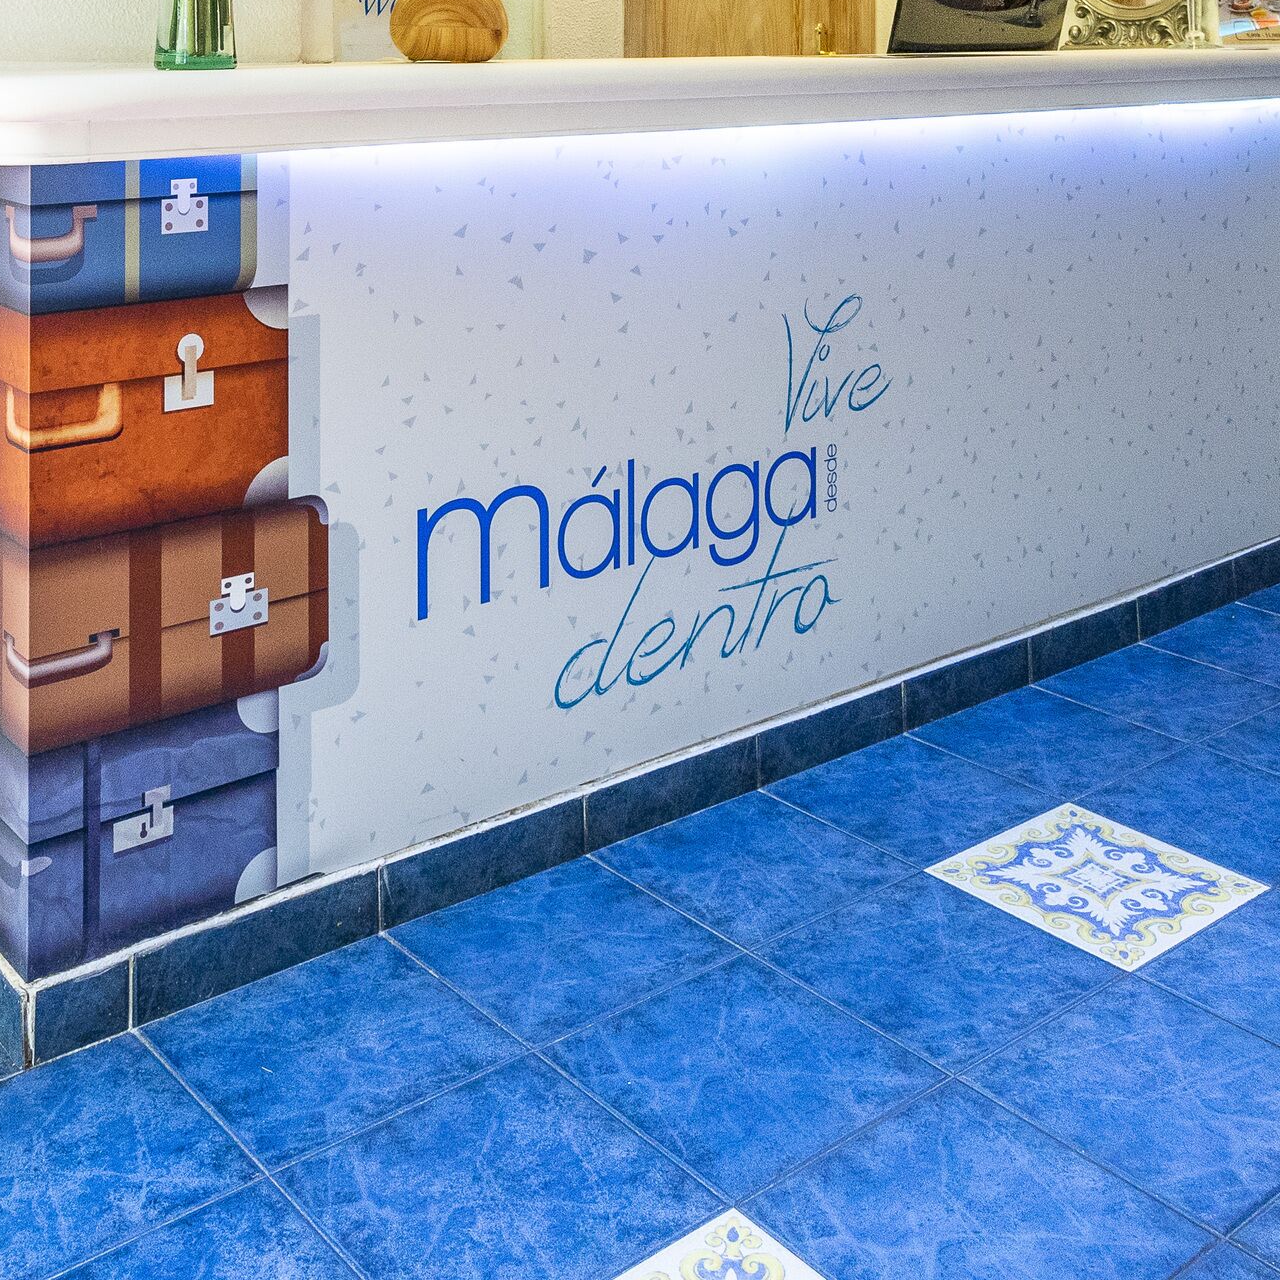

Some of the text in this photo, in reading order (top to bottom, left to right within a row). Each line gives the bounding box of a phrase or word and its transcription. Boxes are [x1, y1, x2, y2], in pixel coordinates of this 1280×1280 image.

[782, 294, 893, 433] Vive
[417, 446, 817, 621] málaga
[823, 442, 838, 513] desde
[554, 499, 843, 709] dentro
